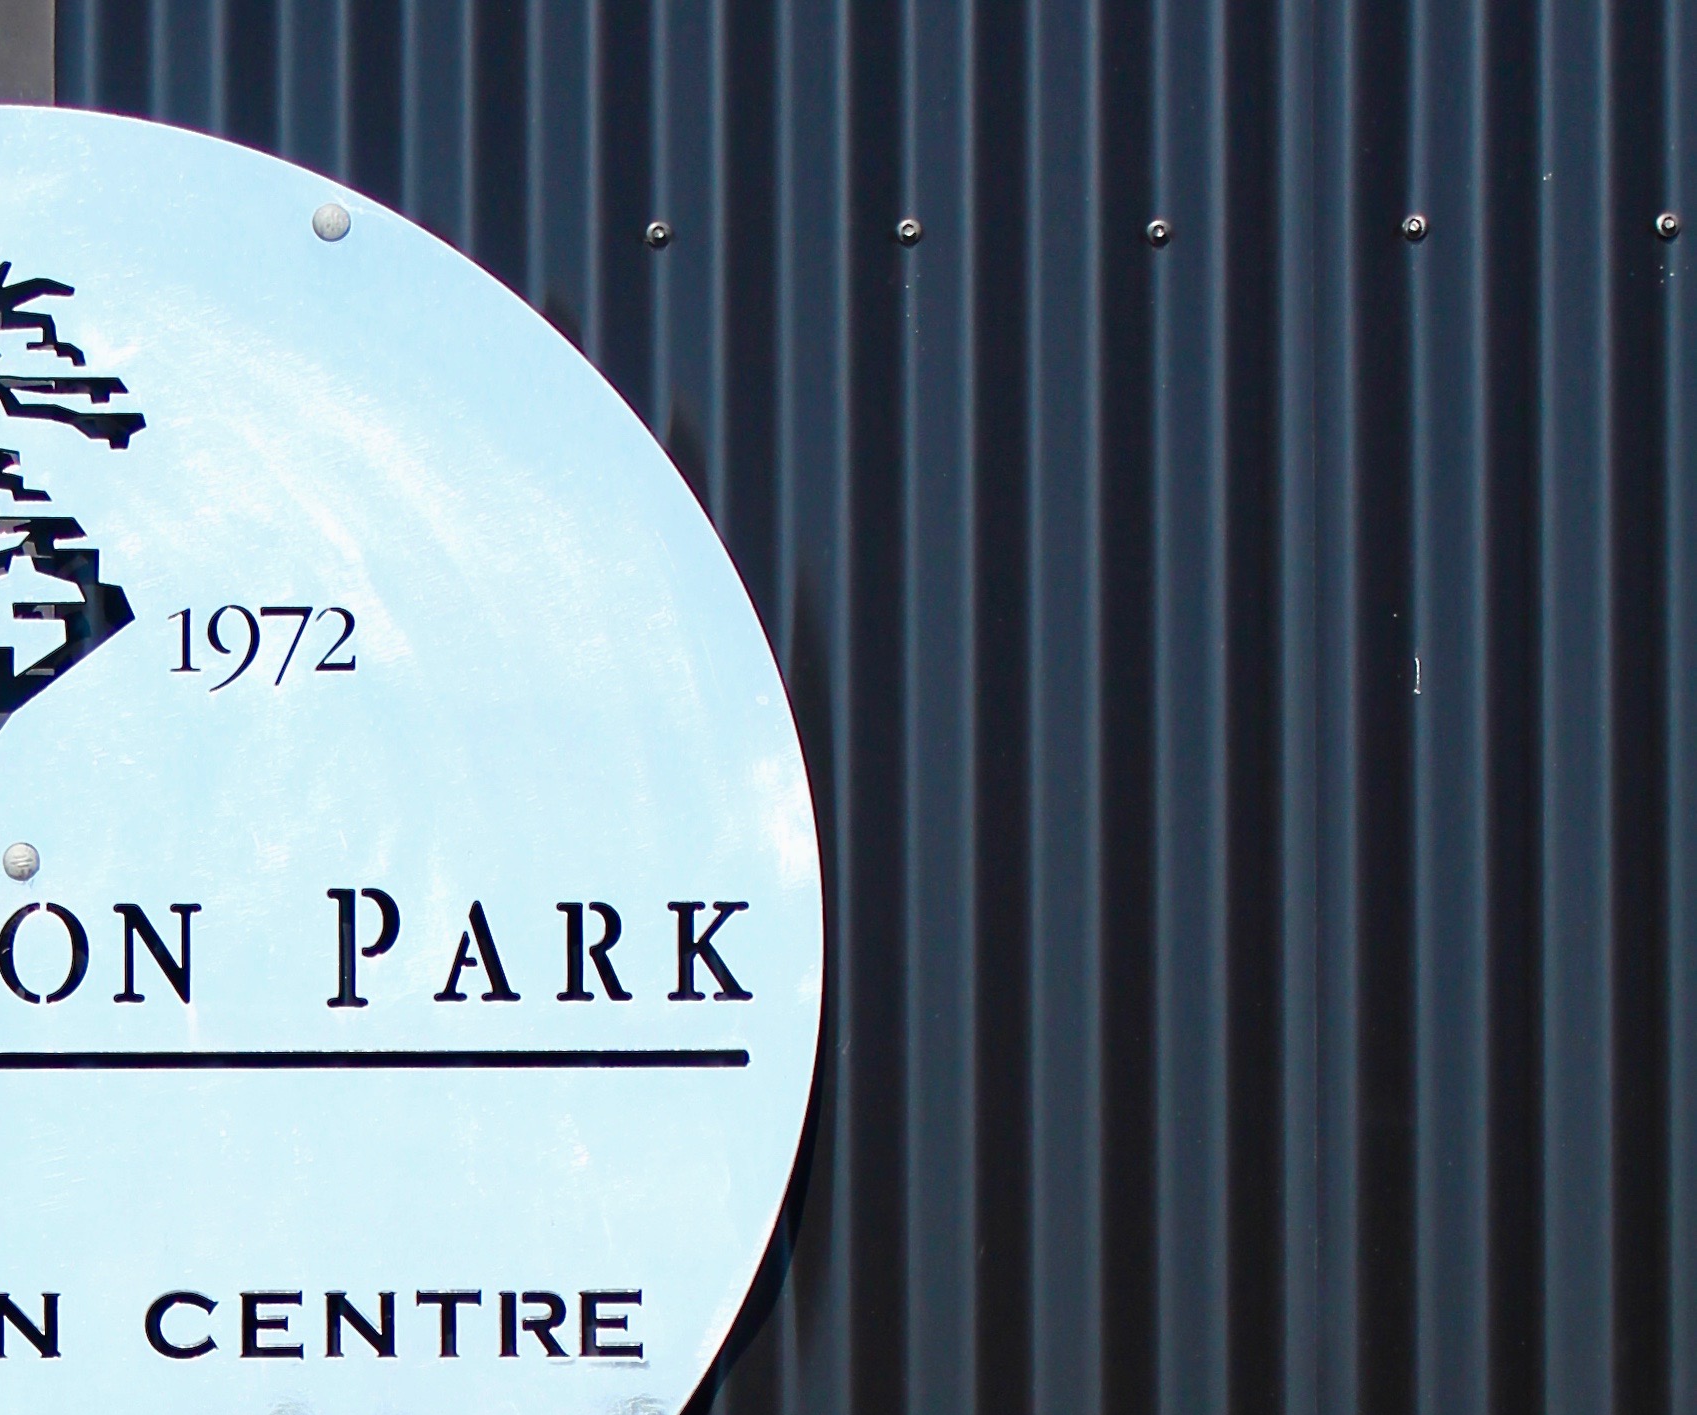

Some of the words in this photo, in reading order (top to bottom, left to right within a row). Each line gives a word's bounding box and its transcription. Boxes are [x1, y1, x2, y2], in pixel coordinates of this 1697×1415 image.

[171, 604, 357, 691] 1972
[325, 887, 755, 1008] PARK
[144, 1289, 645, 1360] CENTRE
